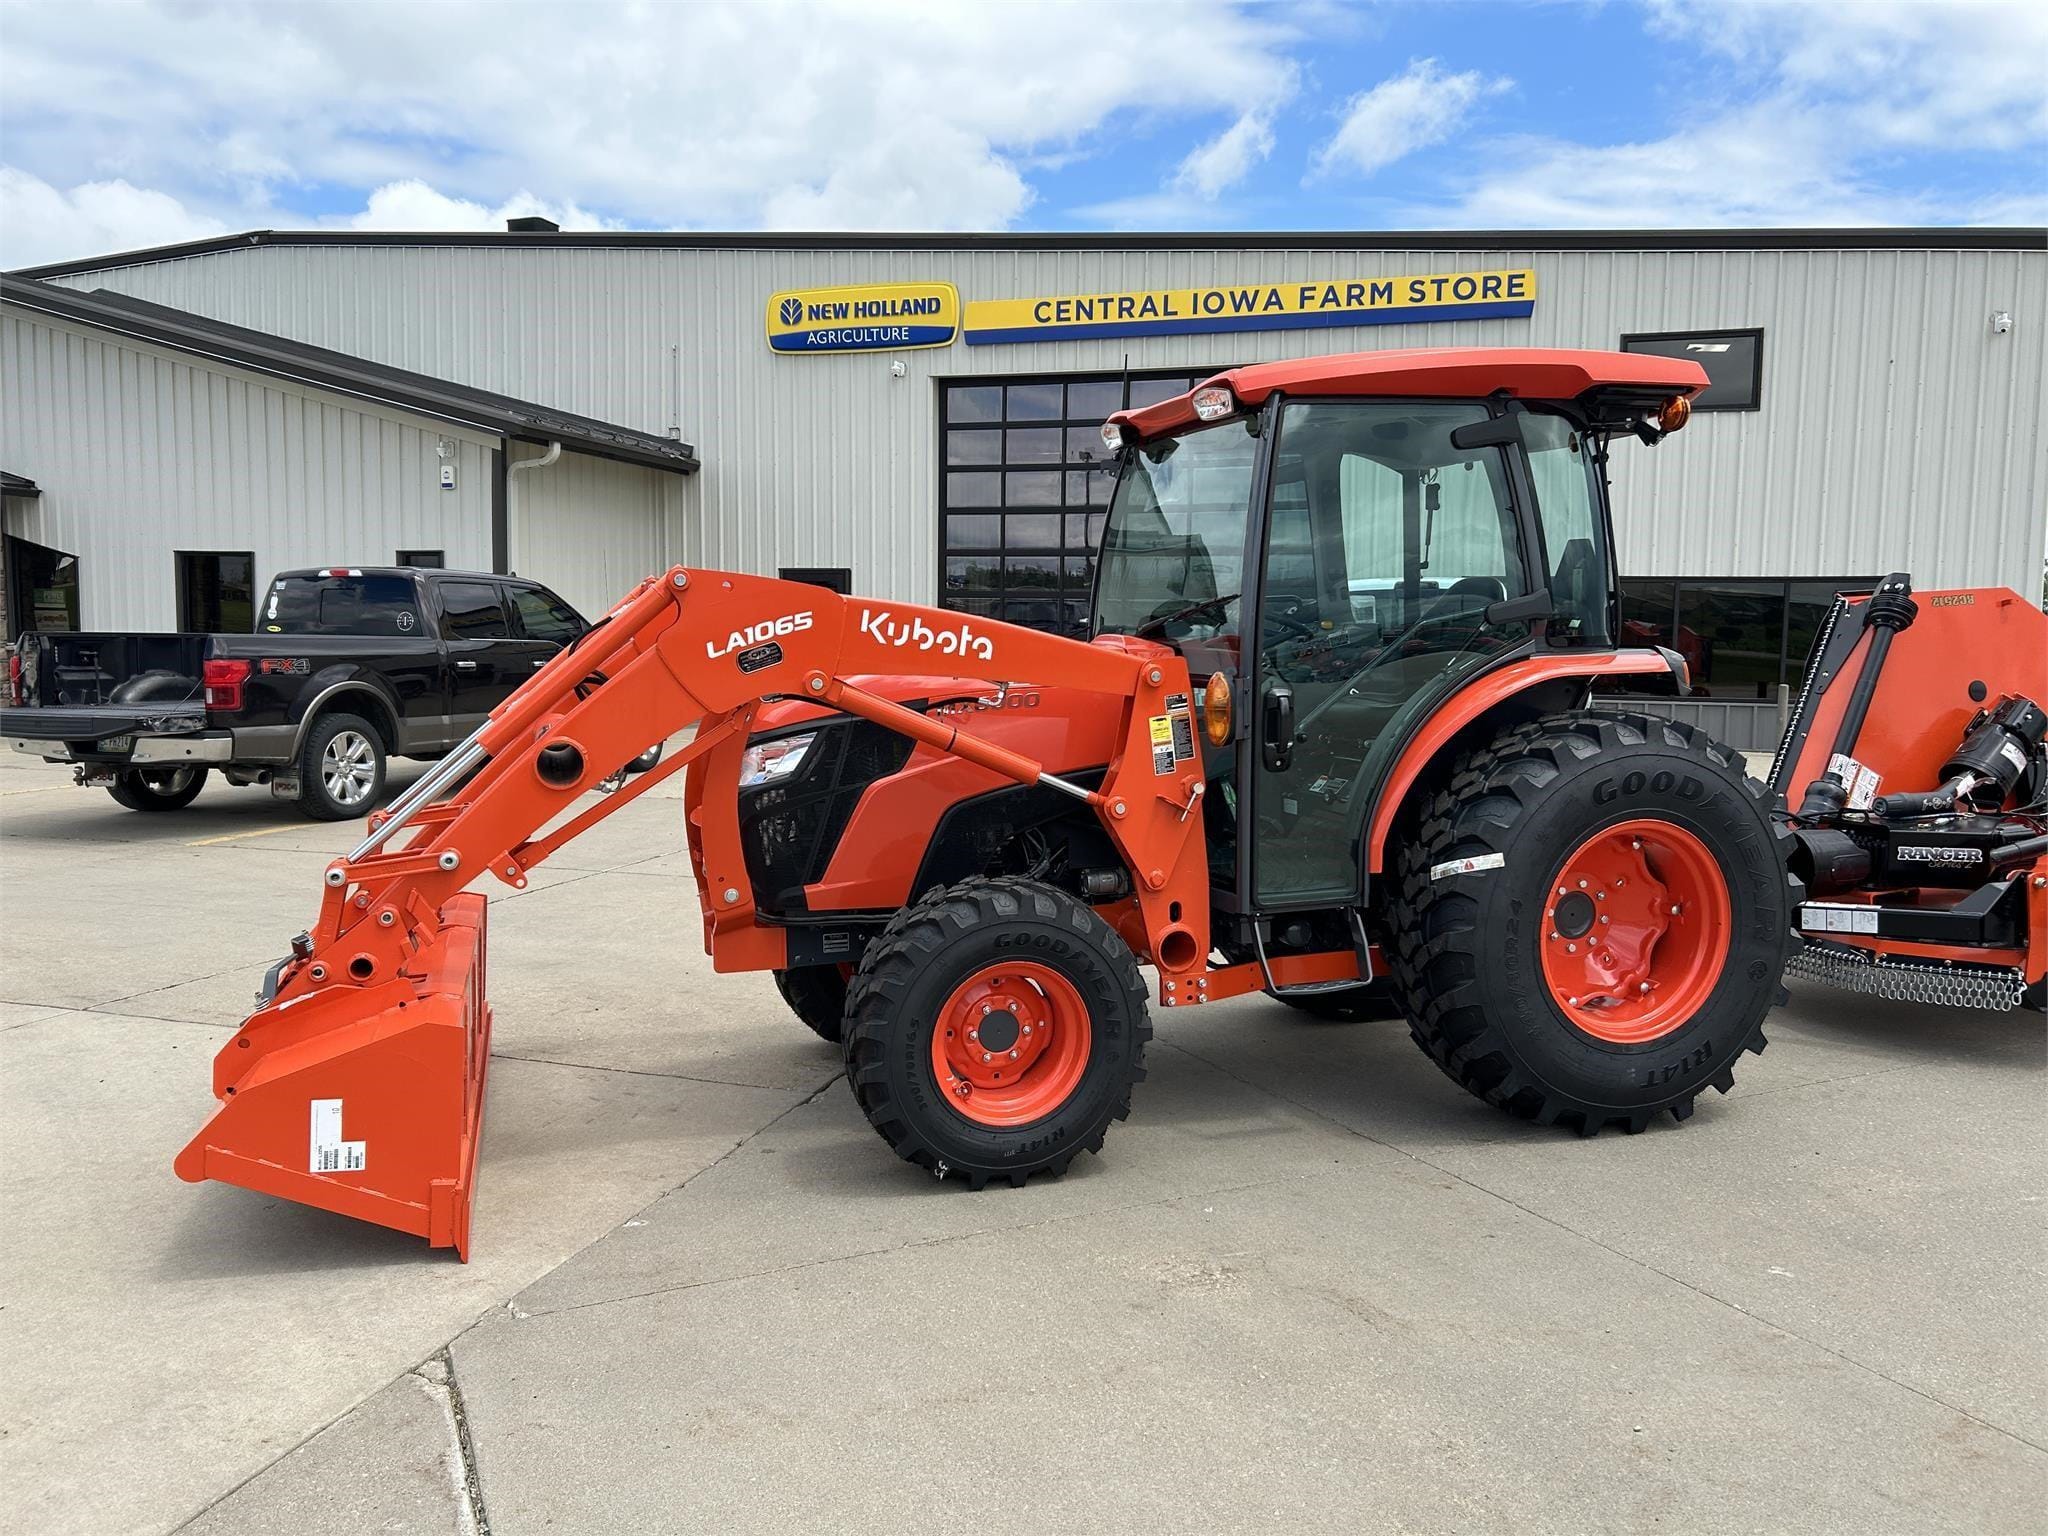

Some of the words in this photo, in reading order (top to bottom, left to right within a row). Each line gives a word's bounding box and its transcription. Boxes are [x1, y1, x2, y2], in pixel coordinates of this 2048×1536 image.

[807, 301, 850, 321] NEW
[853, 297, 942, 319] HOLLAND
[1033, 293, 1179, 324] CENTRAL
[1191, 287, 1285, 316] IOWA
[1299, 281, 1393, 310] FARM
[1408, 273, 1527, 304] STORE
[806, 326, 910, 345] AGRICULTURE
[705, 610, 814, 660] LA1065
[859, 608, 994, 661] Kubota
[260, 658, 310, 674] FX4
[1897, 846, 1983, 863] RANGER
[1640, 1040, 1713, 1089] R14T
